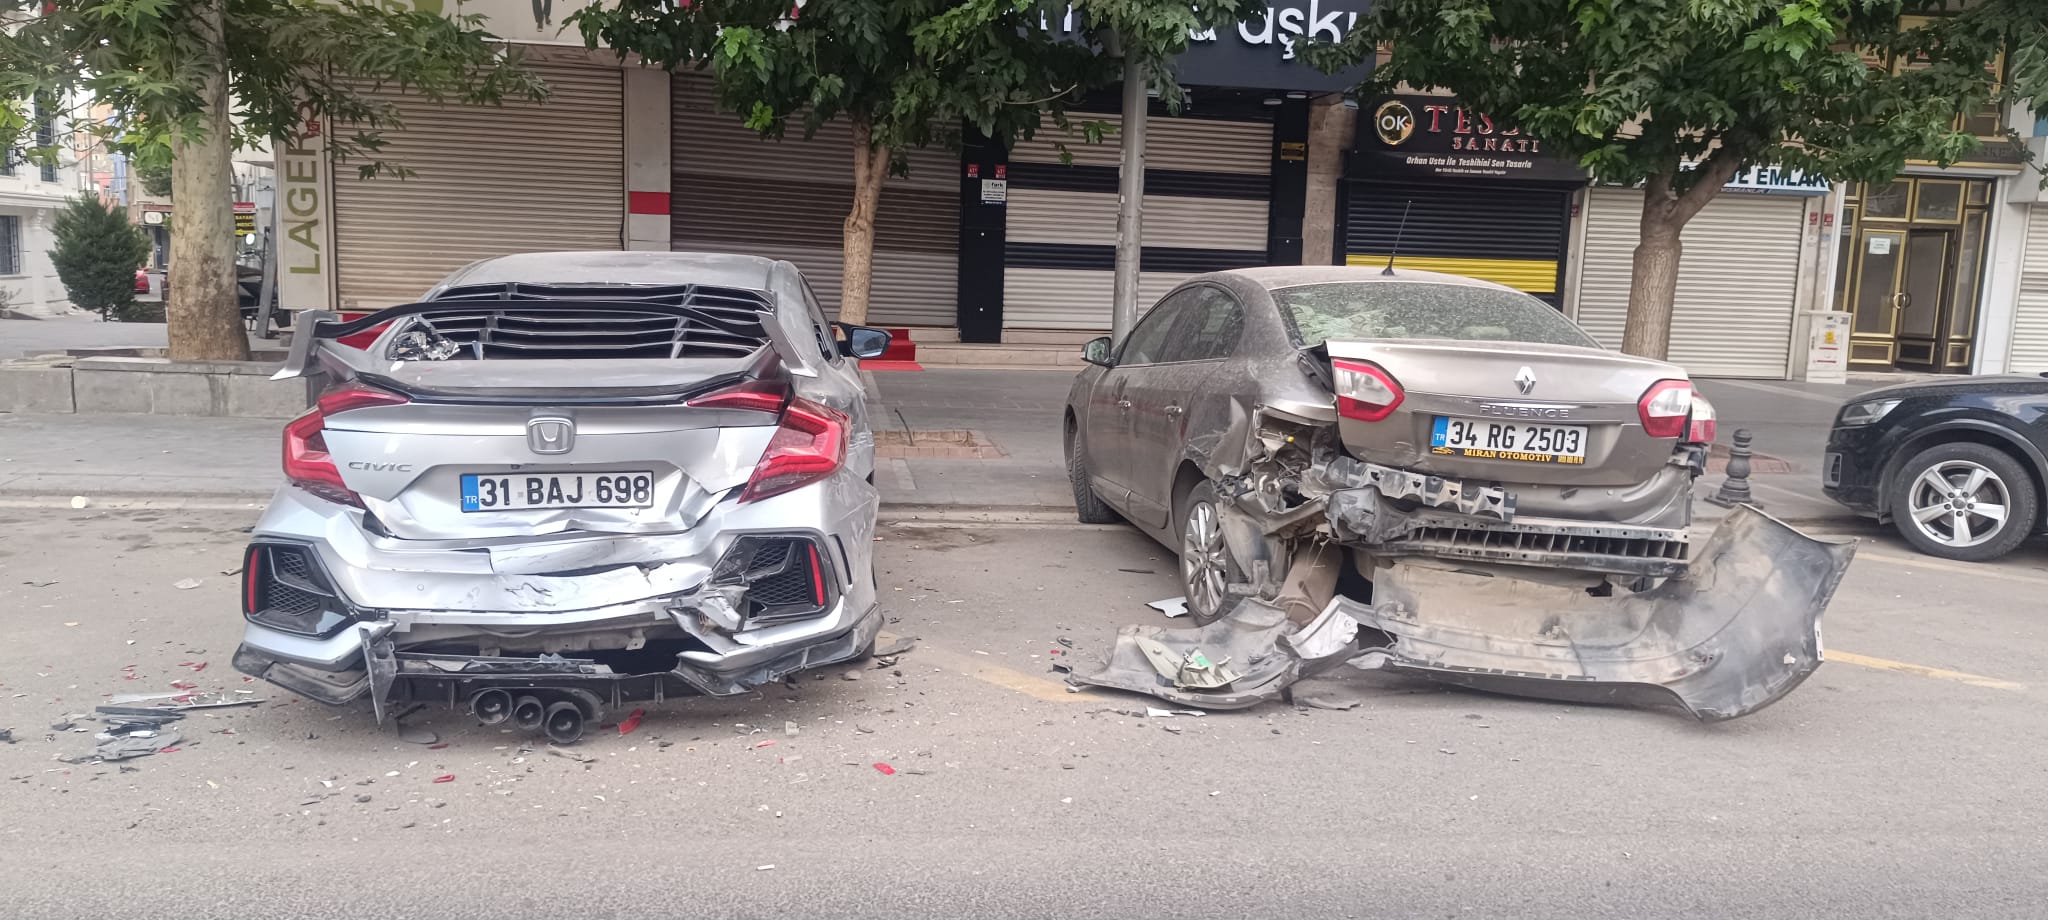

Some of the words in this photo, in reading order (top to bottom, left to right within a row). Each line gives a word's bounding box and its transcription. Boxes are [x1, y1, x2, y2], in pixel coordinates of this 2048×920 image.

[1381, 115, 1407, 131] OK
[1424, 105, 1534, 136] TES
[1452, 136, 1540, 153] SANATI
[1406, 155, 1428, 165] Orhan
[1429, 156, 1446, 166] Usta
[1491, 159, 1505, 168] Sen
[1756, 168, 1826, 188] EMLAK
[1479, 404, 1569, 418] FLUENCE
[1435, 433, 1446, 442] TR
[1450, 421, 1478, 447] 34
[1487, 423, 1516, 449] RG
[1523, 427, 1580, 454] 2503
[348, 461, 412, 473] CIVIC
[465, 495, 478, 504] TR
[479, 478, 511, 507] 31
[526, 476, 583, 506] BAJ
[596, 475, 650, 504] 698
